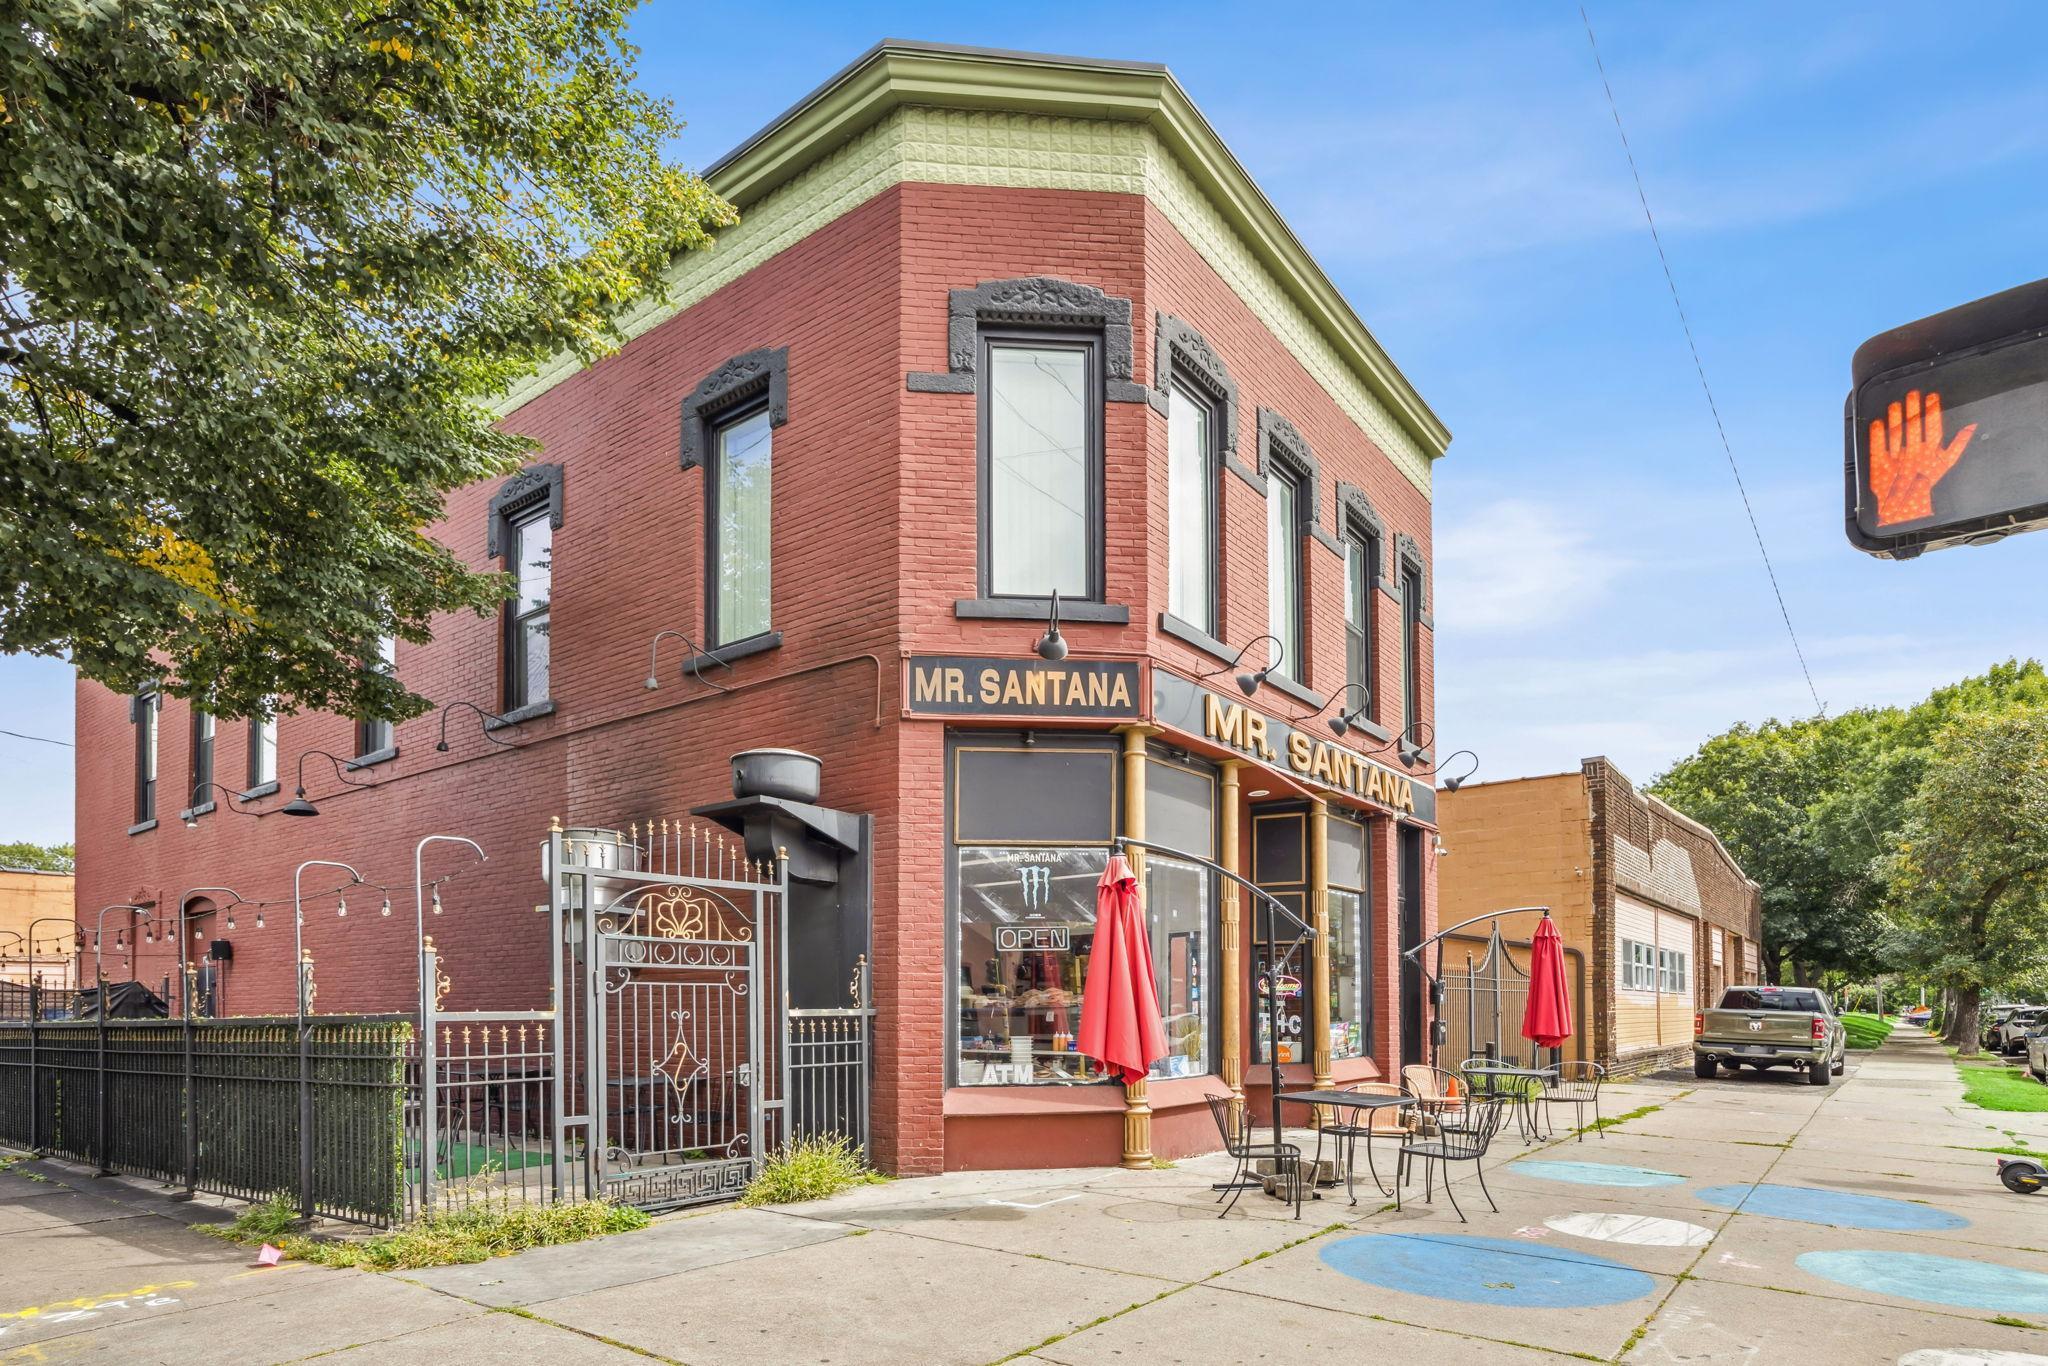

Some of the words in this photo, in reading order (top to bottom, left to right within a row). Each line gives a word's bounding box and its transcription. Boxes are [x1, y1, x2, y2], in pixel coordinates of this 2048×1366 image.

[915, 667, 973, 703] MR.
[980, 668, 1131, 707] SANTANA
[1204, 693, 1276, 761] MR.
[1288, 731, 1415, 814] SANTANA
[1024, 852, 1062, 862] SANTANA
[1000, 929, 1066, 948] OPEN
[982, 1063, 1034, 1085] ATM
